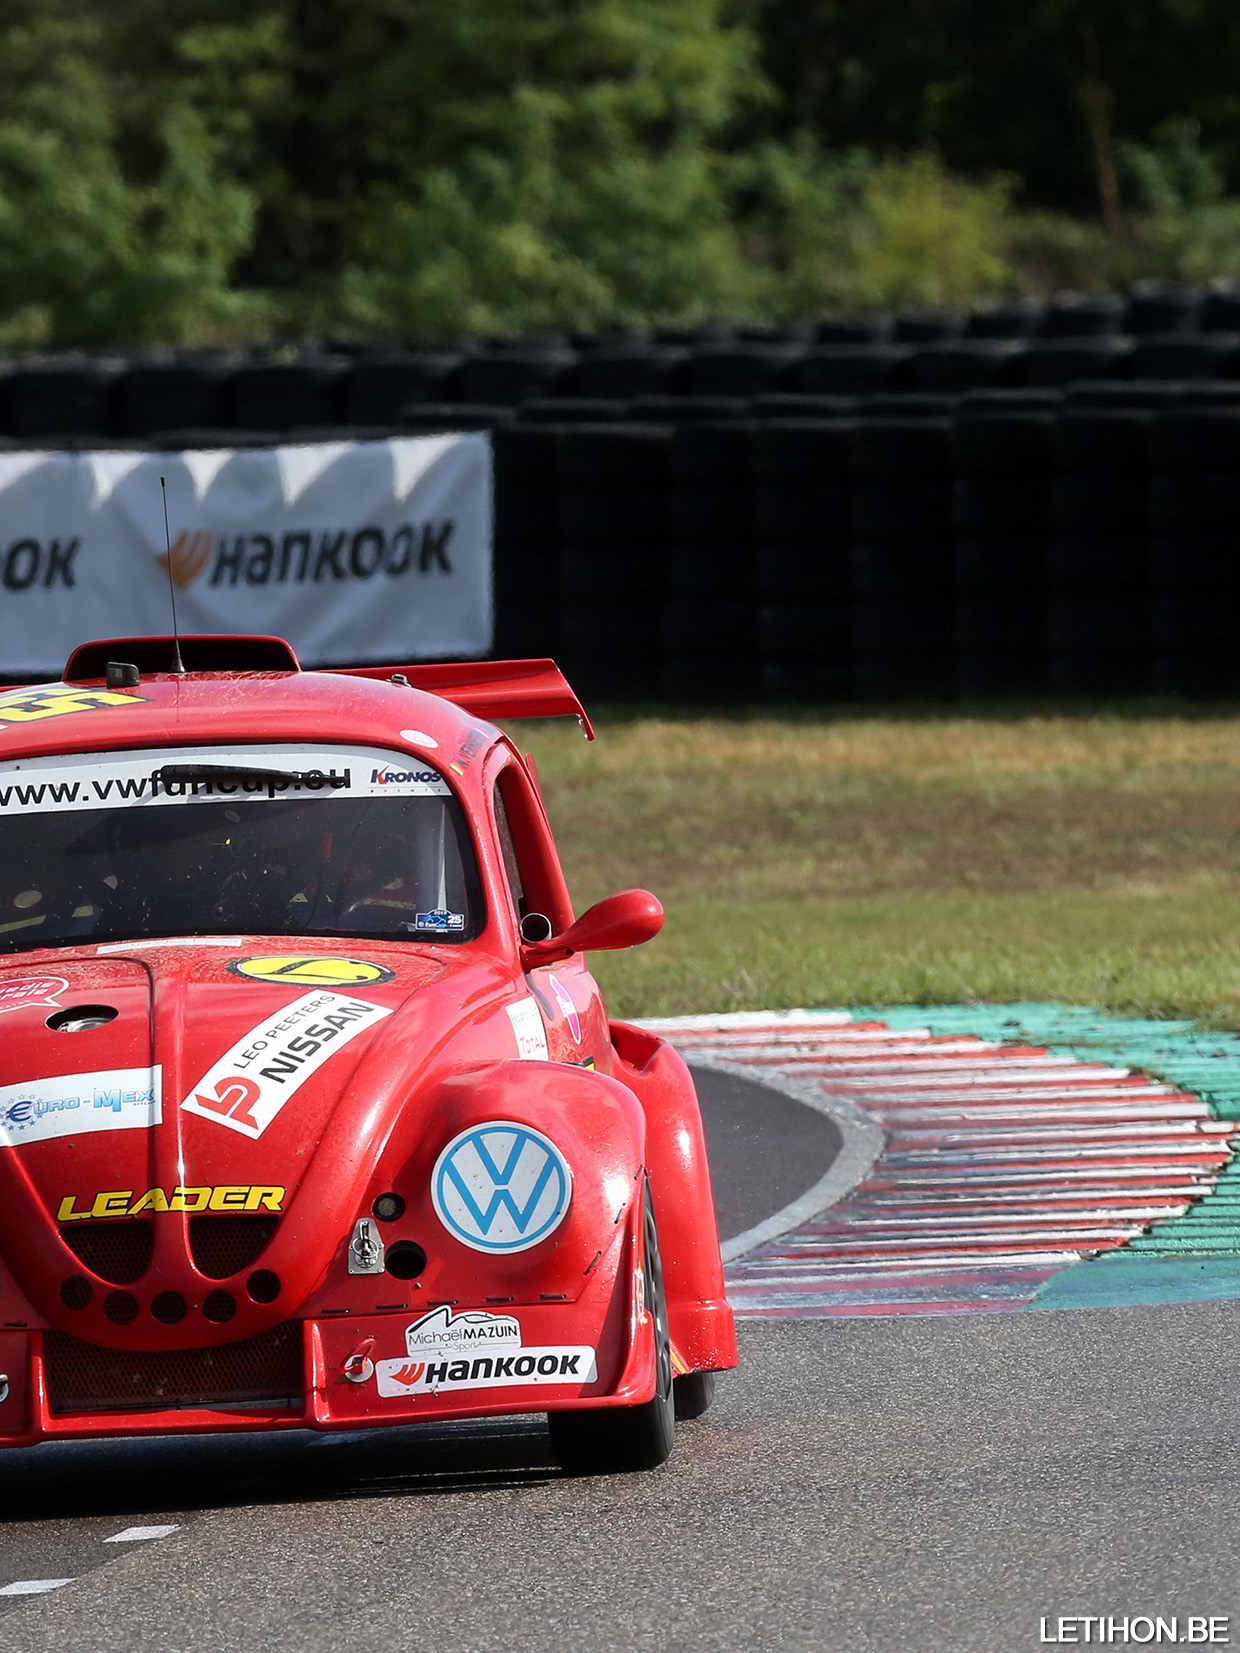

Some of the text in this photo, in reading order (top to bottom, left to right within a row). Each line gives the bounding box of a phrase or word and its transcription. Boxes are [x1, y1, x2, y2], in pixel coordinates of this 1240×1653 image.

[370, 765, 442, 785] KRONOS
[233, 994, 336, 1069] LEO PEETERS
[259, 1002, 376, 1084] NISSAN
[56, 1184, 287, 1222] LEADER
